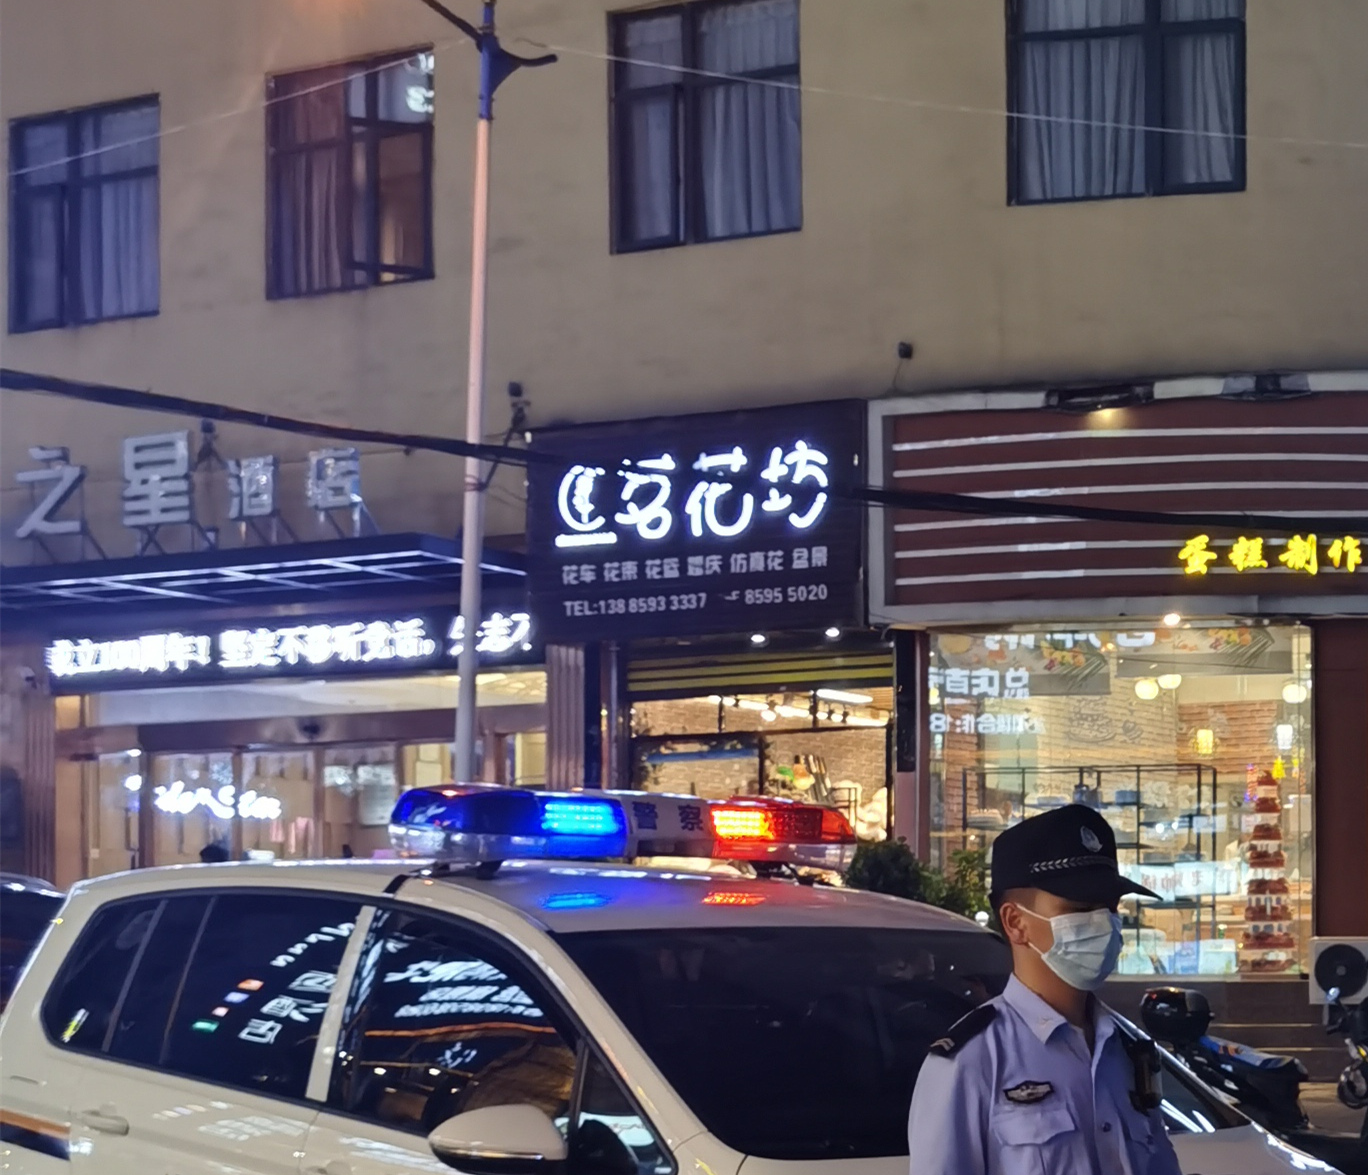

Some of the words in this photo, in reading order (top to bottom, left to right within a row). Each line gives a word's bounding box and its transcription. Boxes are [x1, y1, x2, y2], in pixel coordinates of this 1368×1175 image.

[15, 429, 363, 538] 之星酒店
[1178, 534, 1363, 575] 蛋糕制作
[562, 564, 597, 585] 花车
[632, 801, 704, 831] 警察
